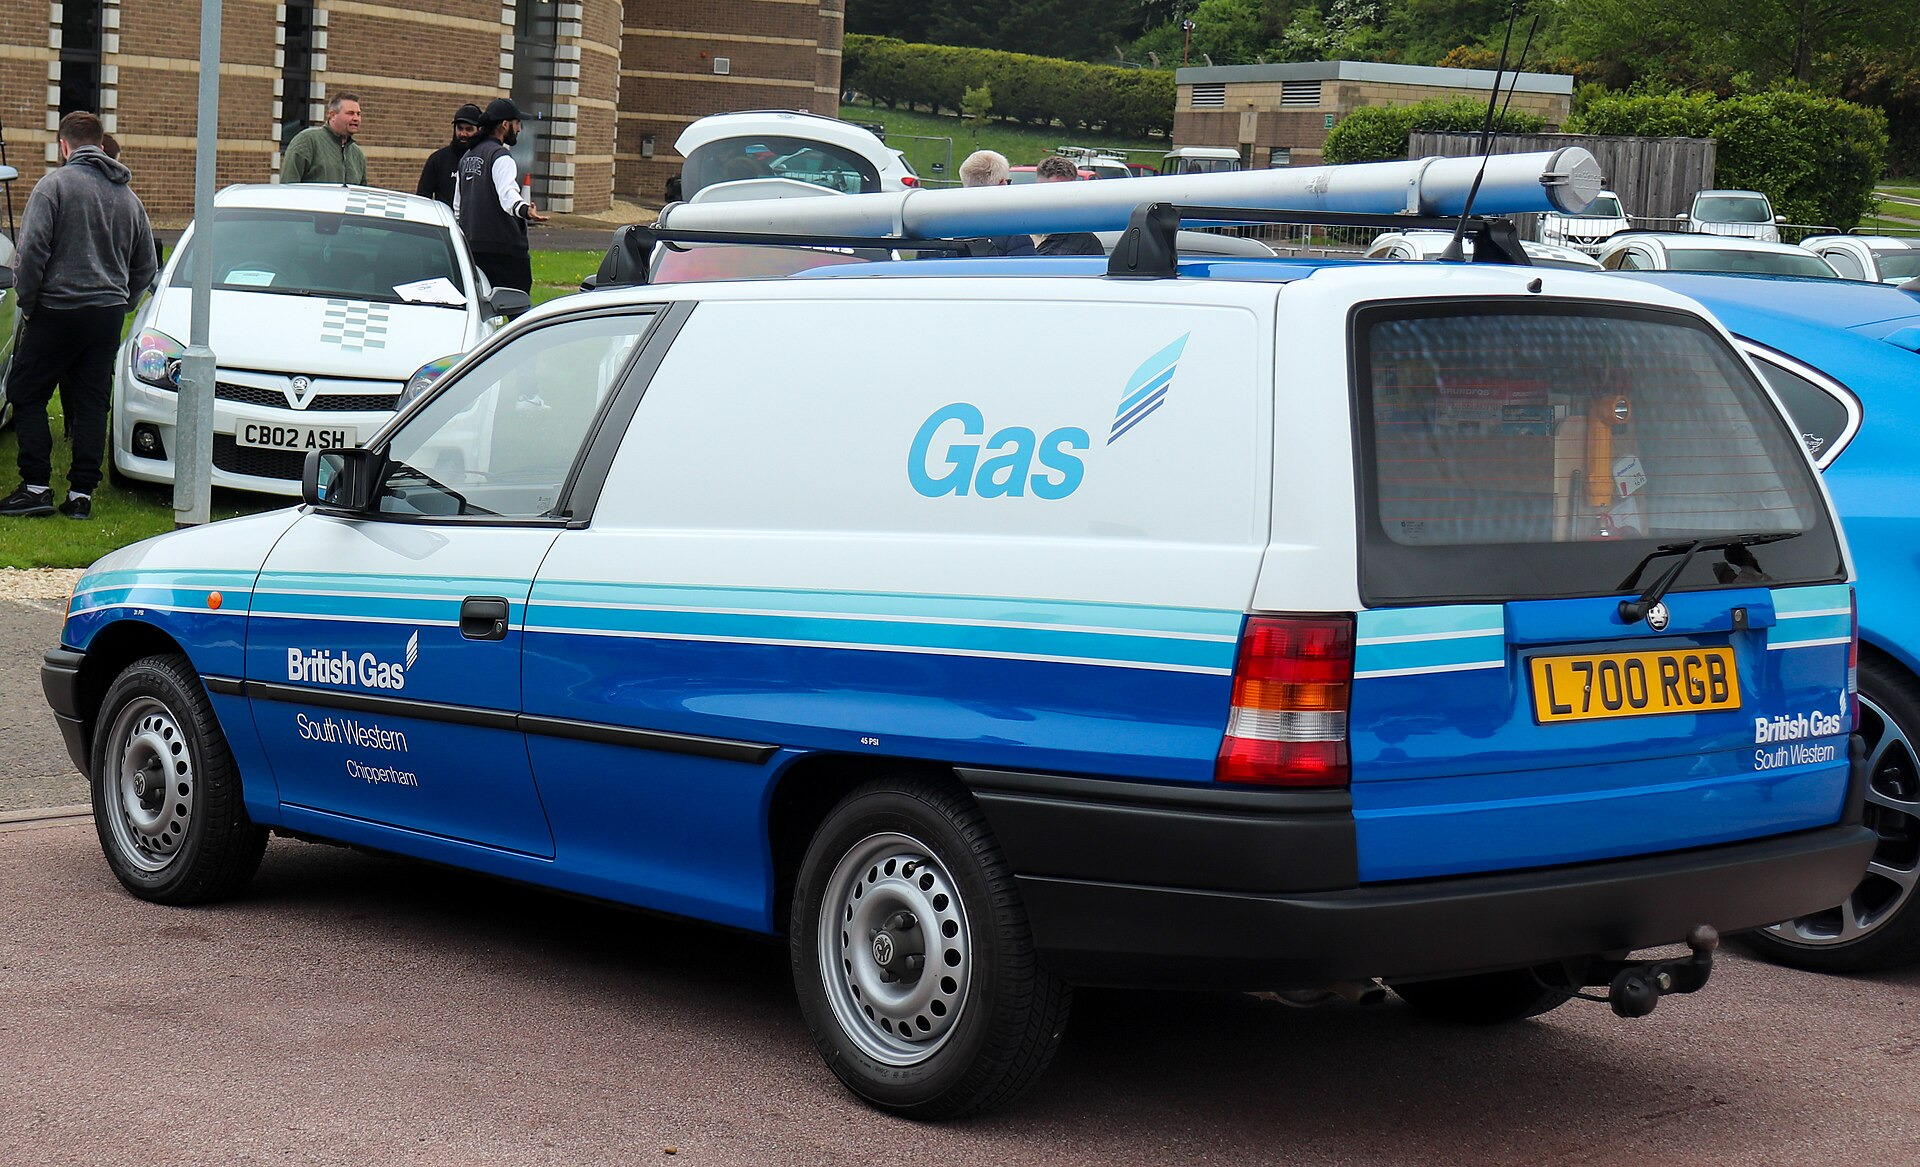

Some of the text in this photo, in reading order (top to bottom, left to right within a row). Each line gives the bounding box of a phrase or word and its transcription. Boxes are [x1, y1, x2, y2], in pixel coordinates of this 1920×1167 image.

[245, 424, 345, 449] CB02 ASH
[907, 402, 1091, 501] Gas
[288, 647, 405, 690] British Gas
[1545, 653, 1729, 715] L700 RGB
[297, 712, 408, 753] South Western
[860, 737, 879, 746] 45 PSI
[1754, 710, 1840, 744] British Gas
[346, 759, 418, 787] Chippenham
[1754, 743, 1834, 771] South Western
